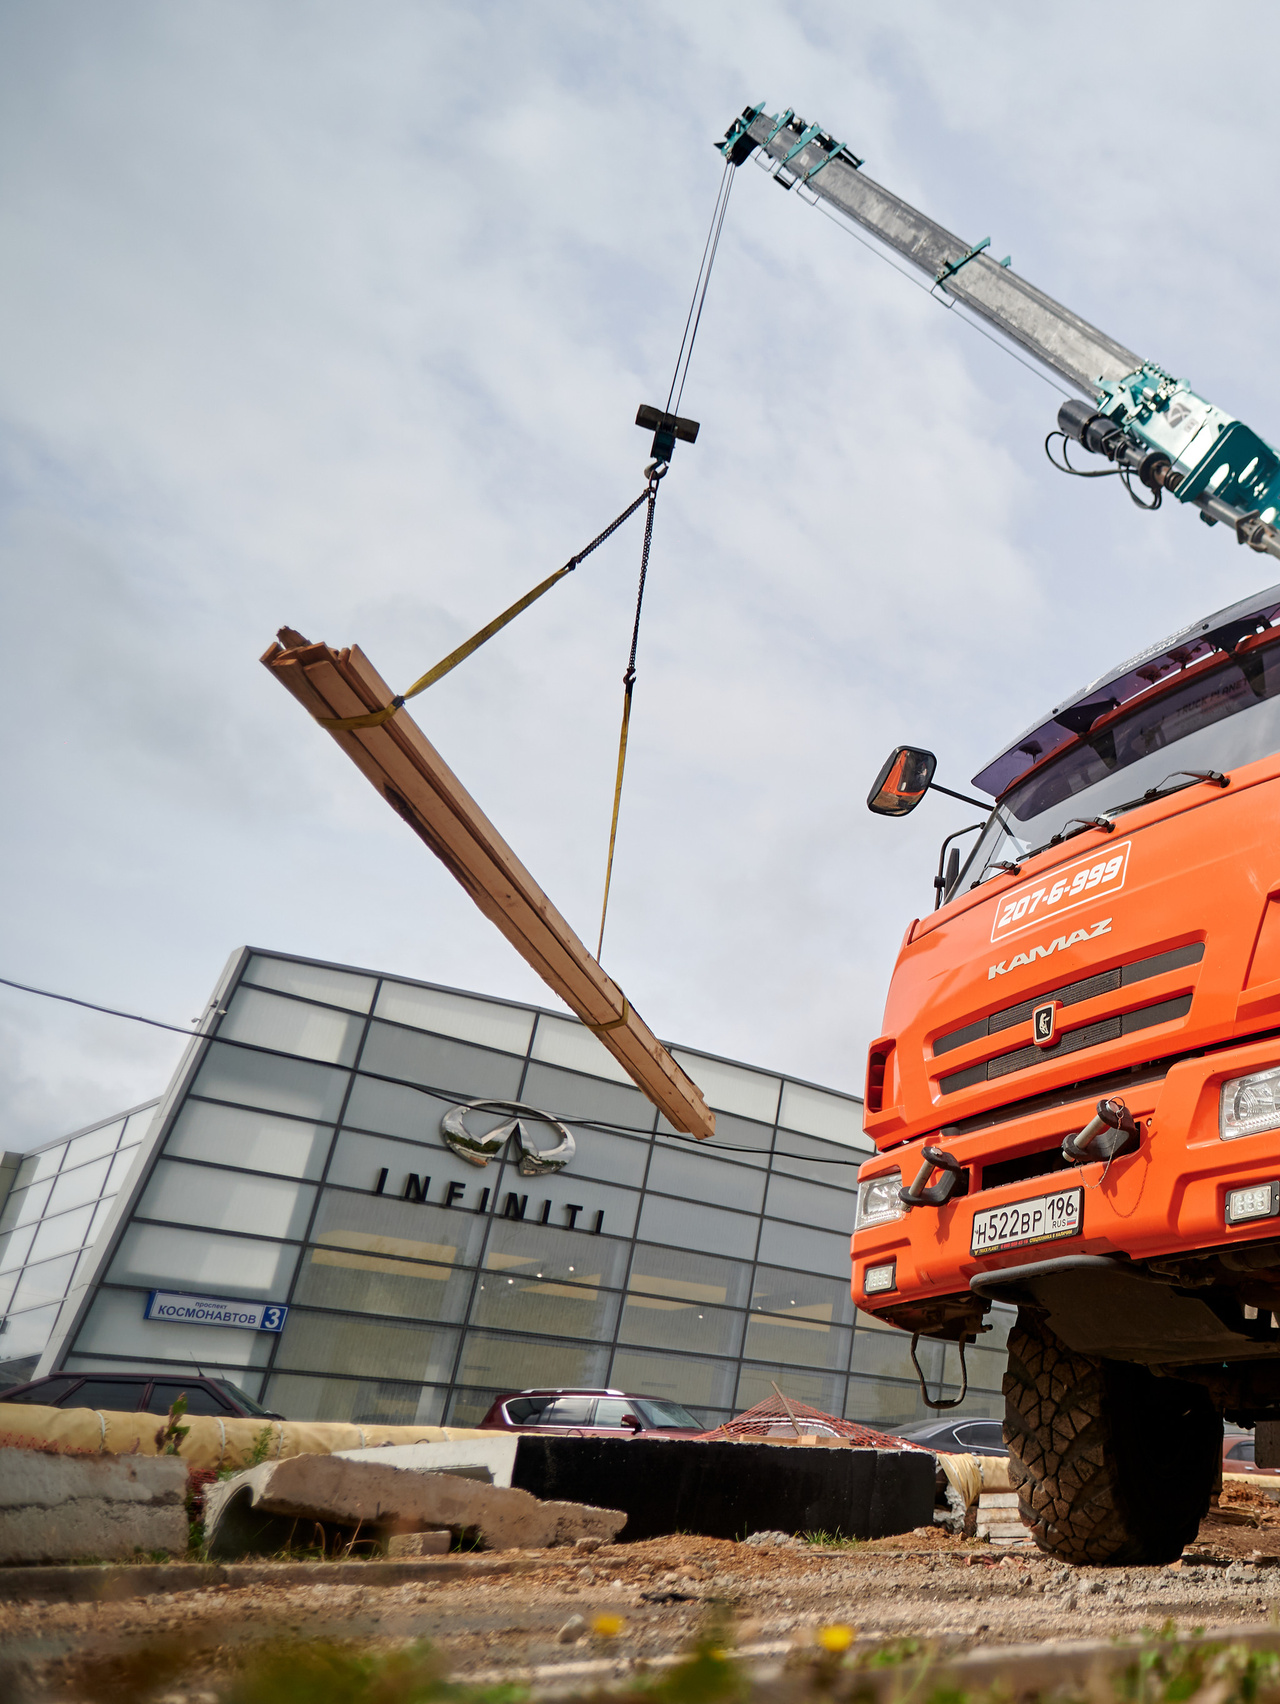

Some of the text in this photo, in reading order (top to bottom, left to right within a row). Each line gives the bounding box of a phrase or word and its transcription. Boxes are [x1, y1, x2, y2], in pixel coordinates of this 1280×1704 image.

[997, 855, 1124, 929] 207-6-999
[988, 917, 1113, 980] KAMAZ
[376, 1167, 604, 1234] INFINITI
[1047, 1195, 1075, 1220] 196
[1052, 1219, 1066, 1229] RUS
[157, 1305, 257, 1324] КОСМОНАВТОВ
[195, 1301, 228, 1310] проспект
[264, 1308, 281, 1329] 3
